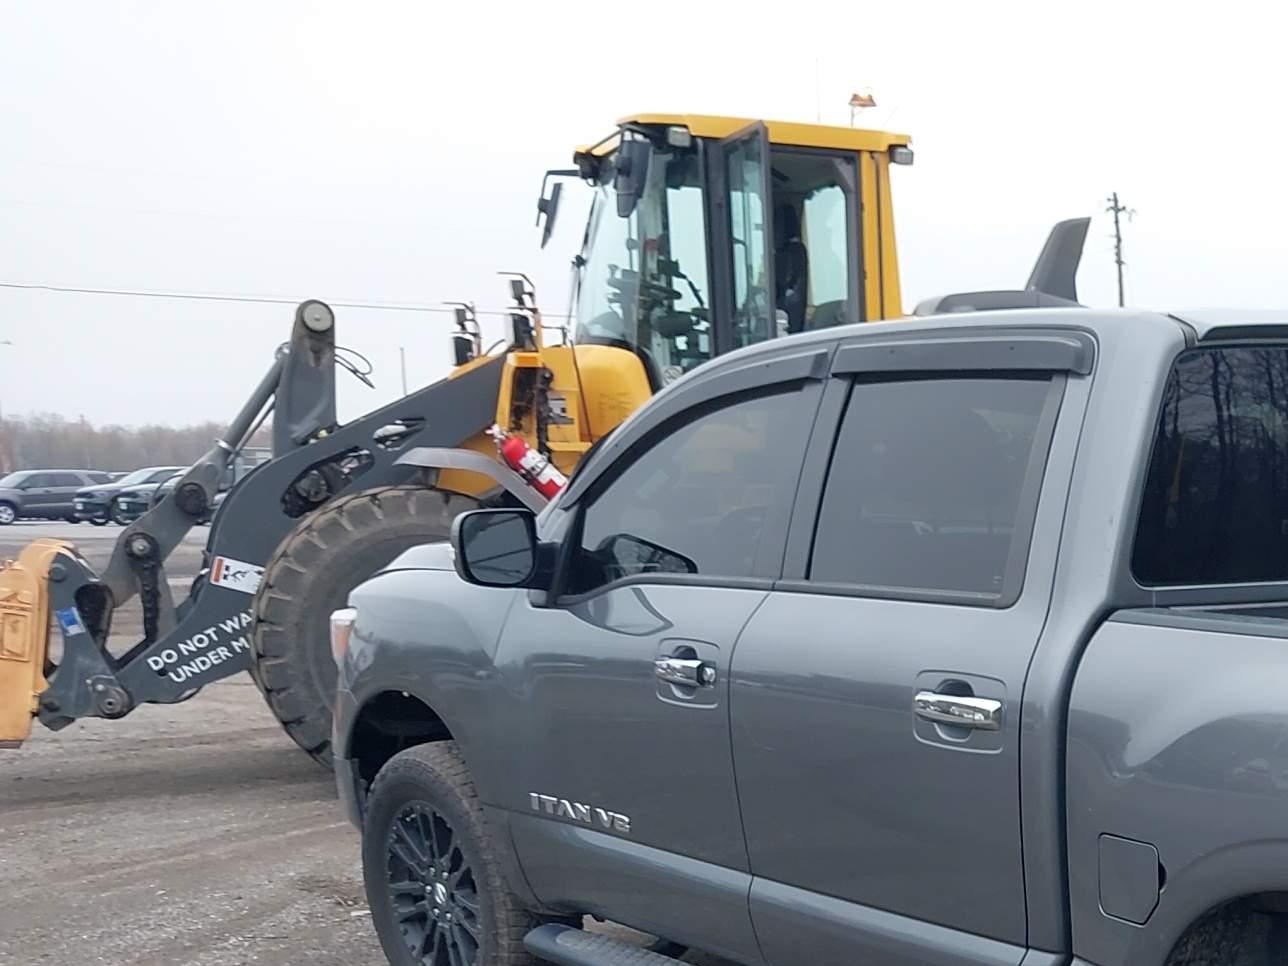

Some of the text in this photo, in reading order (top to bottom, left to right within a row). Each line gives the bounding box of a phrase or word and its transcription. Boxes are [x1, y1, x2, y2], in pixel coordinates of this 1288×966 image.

[147, 609, 254, 671] DO NOT WA
[168, 646, 233, 682] UNDER
